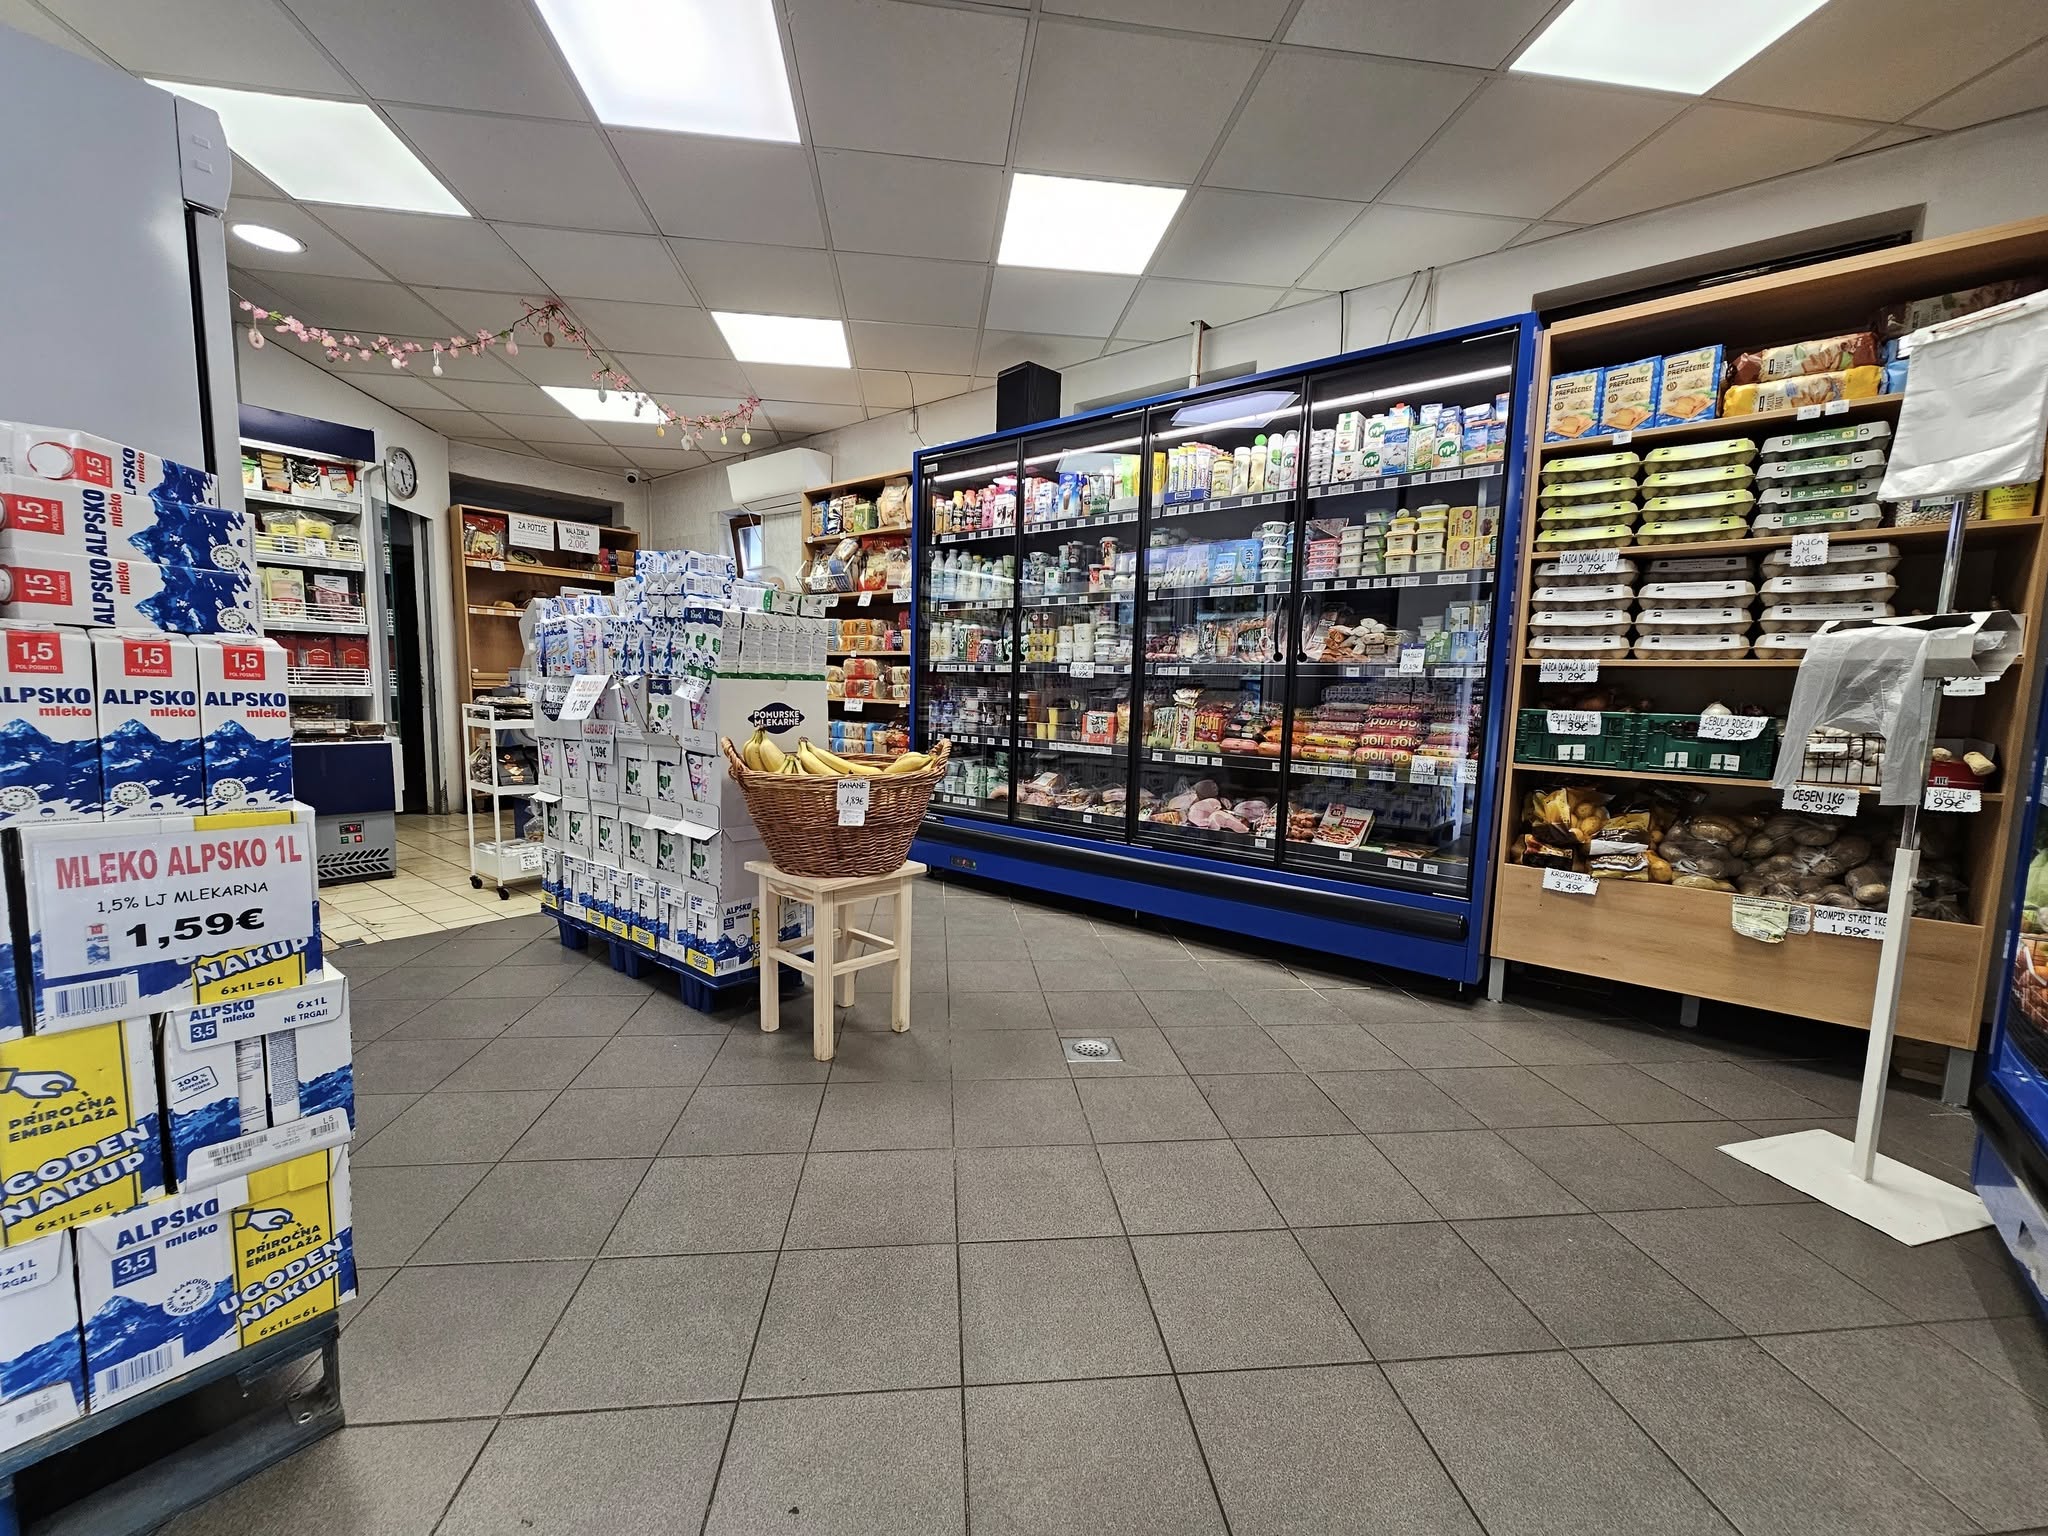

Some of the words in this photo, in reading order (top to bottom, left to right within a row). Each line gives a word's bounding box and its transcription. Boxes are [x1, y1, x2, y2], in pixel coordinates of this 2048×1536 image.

[87, 456, 102, 478] 1,5
[123, 446, 137, 496] LPSKO
[136, 452, 146, 483] mleko
[17, 501, 49, 525] 1,5
[108, 493, 124, 527] mleko
[82, 489, 109, 557] ALPSKO
[116, 562, 131, 595] mleko
[1577, 563, 1607, 575] 2,79€
[24, 573, 58, 597] 1,5
[89, 558, 116, 626] ALPSKO
[17, 642, 54, 662] 1,5
[131, 647, 164, 667] 1,5
[230, 652, 259, 672] 1,5
[1557, 672, 1587, 682] 3,29€
[102, 688, 196, 706] ALPSKO
[204, 691, 287, 707] ALPSKO
[39, 706, 92, 717] mleko
[150, 707, 197, 718] mleko
[246, 708, 287, 718] mleko
[754, 710, 800, 719] POMURSKE
[754, 718, 800, 727] MLEKARNE
[1556, 720, 1588, 733] 1,39€
[1714, 727, 1752, 738] 2,99€
[589, 745, 607, 758] 1,39€
[1361, 735, 1385, 748] poli
[1361, 750, 1386, 763] poli
[839, 781, 867, 790] BANANE
[1801, 802, 1840, 814] 6,99€
[1826, 792, 1845, 805] 1KG
[56, 849, 158, 890] MLEKO
[167, 838, 268, 877] ALPSKO
[274, 835, 302, 863] 1L
[1550, 870, 1583, 882] KROMPIR
[97, 896, 139, 914] 1,5%
[145, 894, 168, 907] LJ
[174, 881, 268, 903] MLEKARNA
[725, 902, 752, 916] ALPSKO
[1814, 909, 1846, 922] KROMPIR
[1847, 913, 1871, 925] STARI
[126, 908, 265, 949] 1,59€
[1831, 924, 1870, 937] 1,59€
[194, 937, 309, 984] NAKUP
[189, 1000, 255, 1022] ALPSKO
[222, 1011, 255, 1024] mleko
[283, 1015, 297, 1024] NE
[298, 1009, 328, 1021] TRGAJ!
[192, 1023, 216, 1039] 3,5
[176, 1075, 199, 1088] 100
[8, 1096, 116, 1129] PRIROČNA
[9, 1107, 118, 1143] EMBALAŽA
[2, 1123, 151, 1196] GODEN
[0, 1152, 145, 1227] NAKUP
[116, 1197, 219, 1250] ALPSKO
[165, 1223, 218, 1249] mleko
[246, 1224, 321, 1258] PRIROČNA
[246, 1234, 322, 1269] EMBALAŽA
[118, 1251, 151, 1276] 3,5
[172, 1278, 212, 1294] KAKOVOST
[218, 1237, 344, 1315] UGODEN
[238, 1260, 340, 1328] NAKUP
